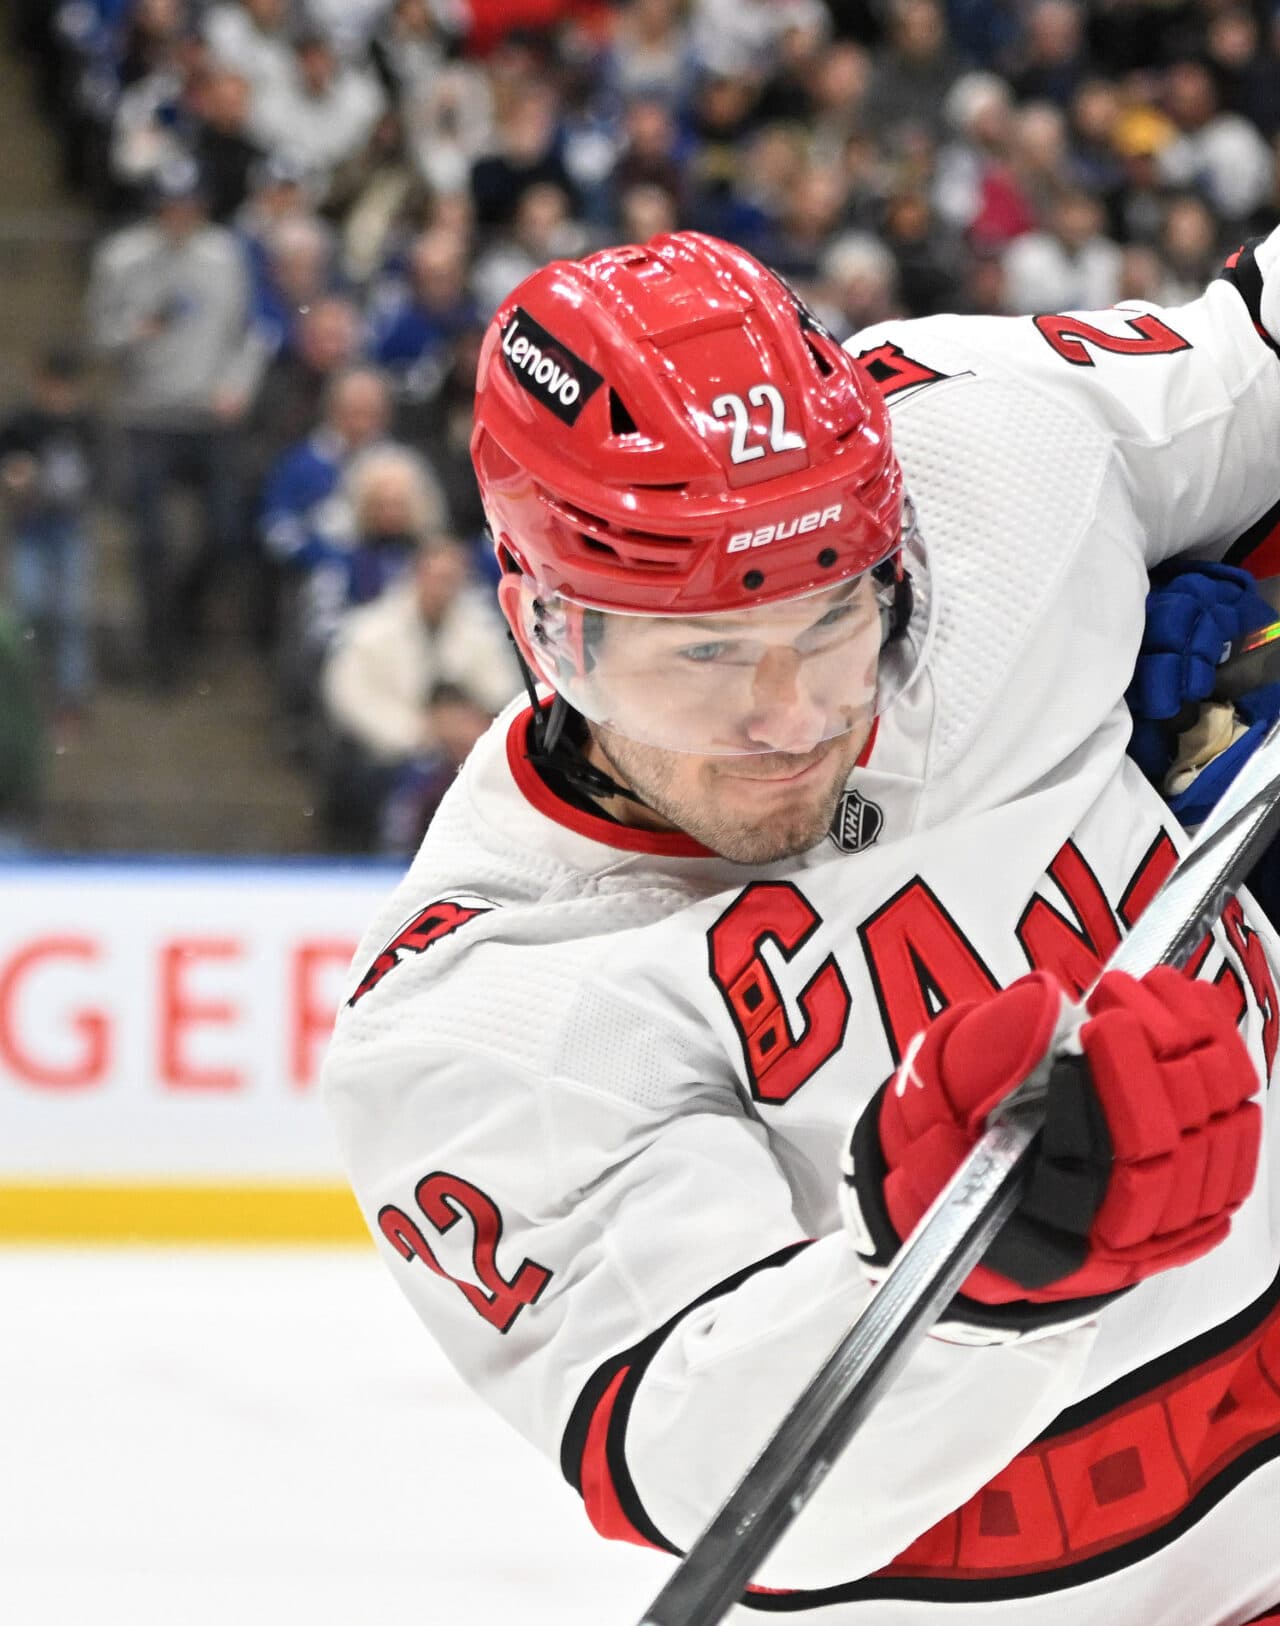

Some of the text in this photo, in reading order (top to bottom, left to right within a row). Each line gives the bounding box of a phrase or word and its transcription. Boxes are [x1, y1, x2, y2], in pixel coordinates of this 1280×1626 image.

[503, 320, 580, 406] Lenovo
[713, 385, 806, 465] 22
[844, 803, 860, 846] NHL
[378, 1171, 554, 1334] 22
